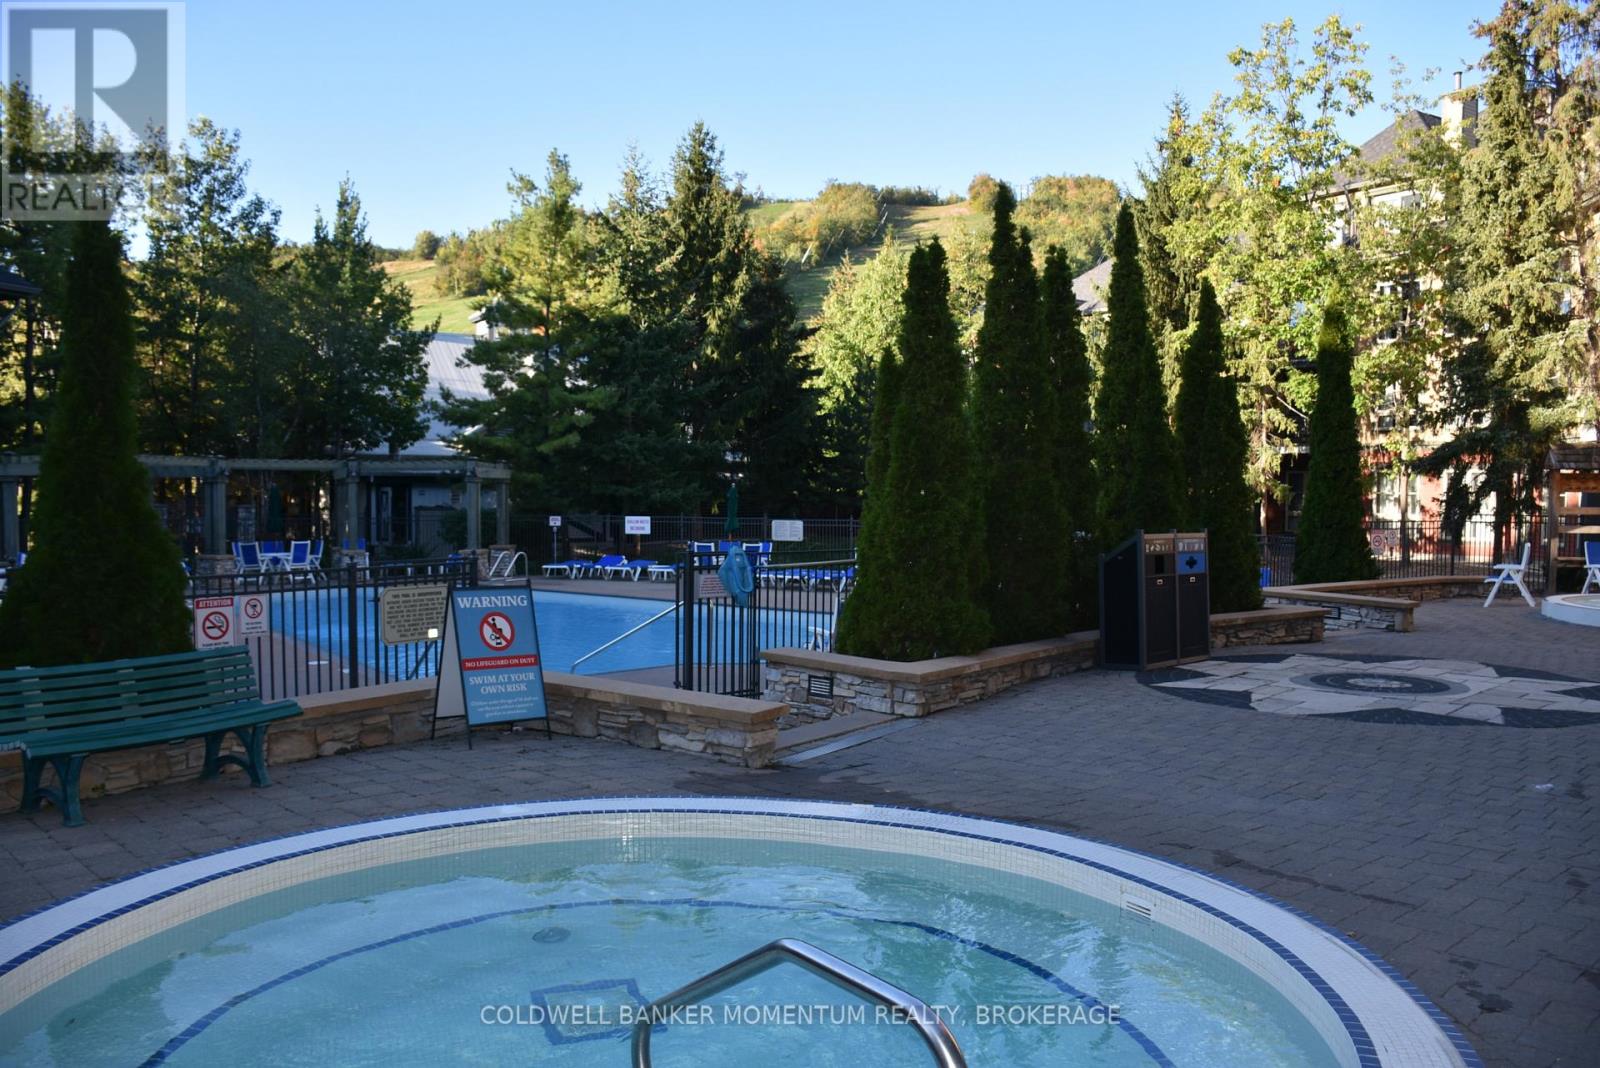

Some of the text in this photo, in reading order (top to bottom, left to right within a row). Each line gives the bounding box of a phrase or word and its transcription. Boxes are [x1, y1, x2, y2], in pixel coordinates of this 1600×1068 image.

[199, 599, 232, 608] ATTENTION
[457, 595, 528, 609] WARNING
[476, 659, 509, 667] LIFEGUARD
[469, 672, 536, 685] SWIM AT YOUR
[480, 683, 527, 694] OWN RISK
